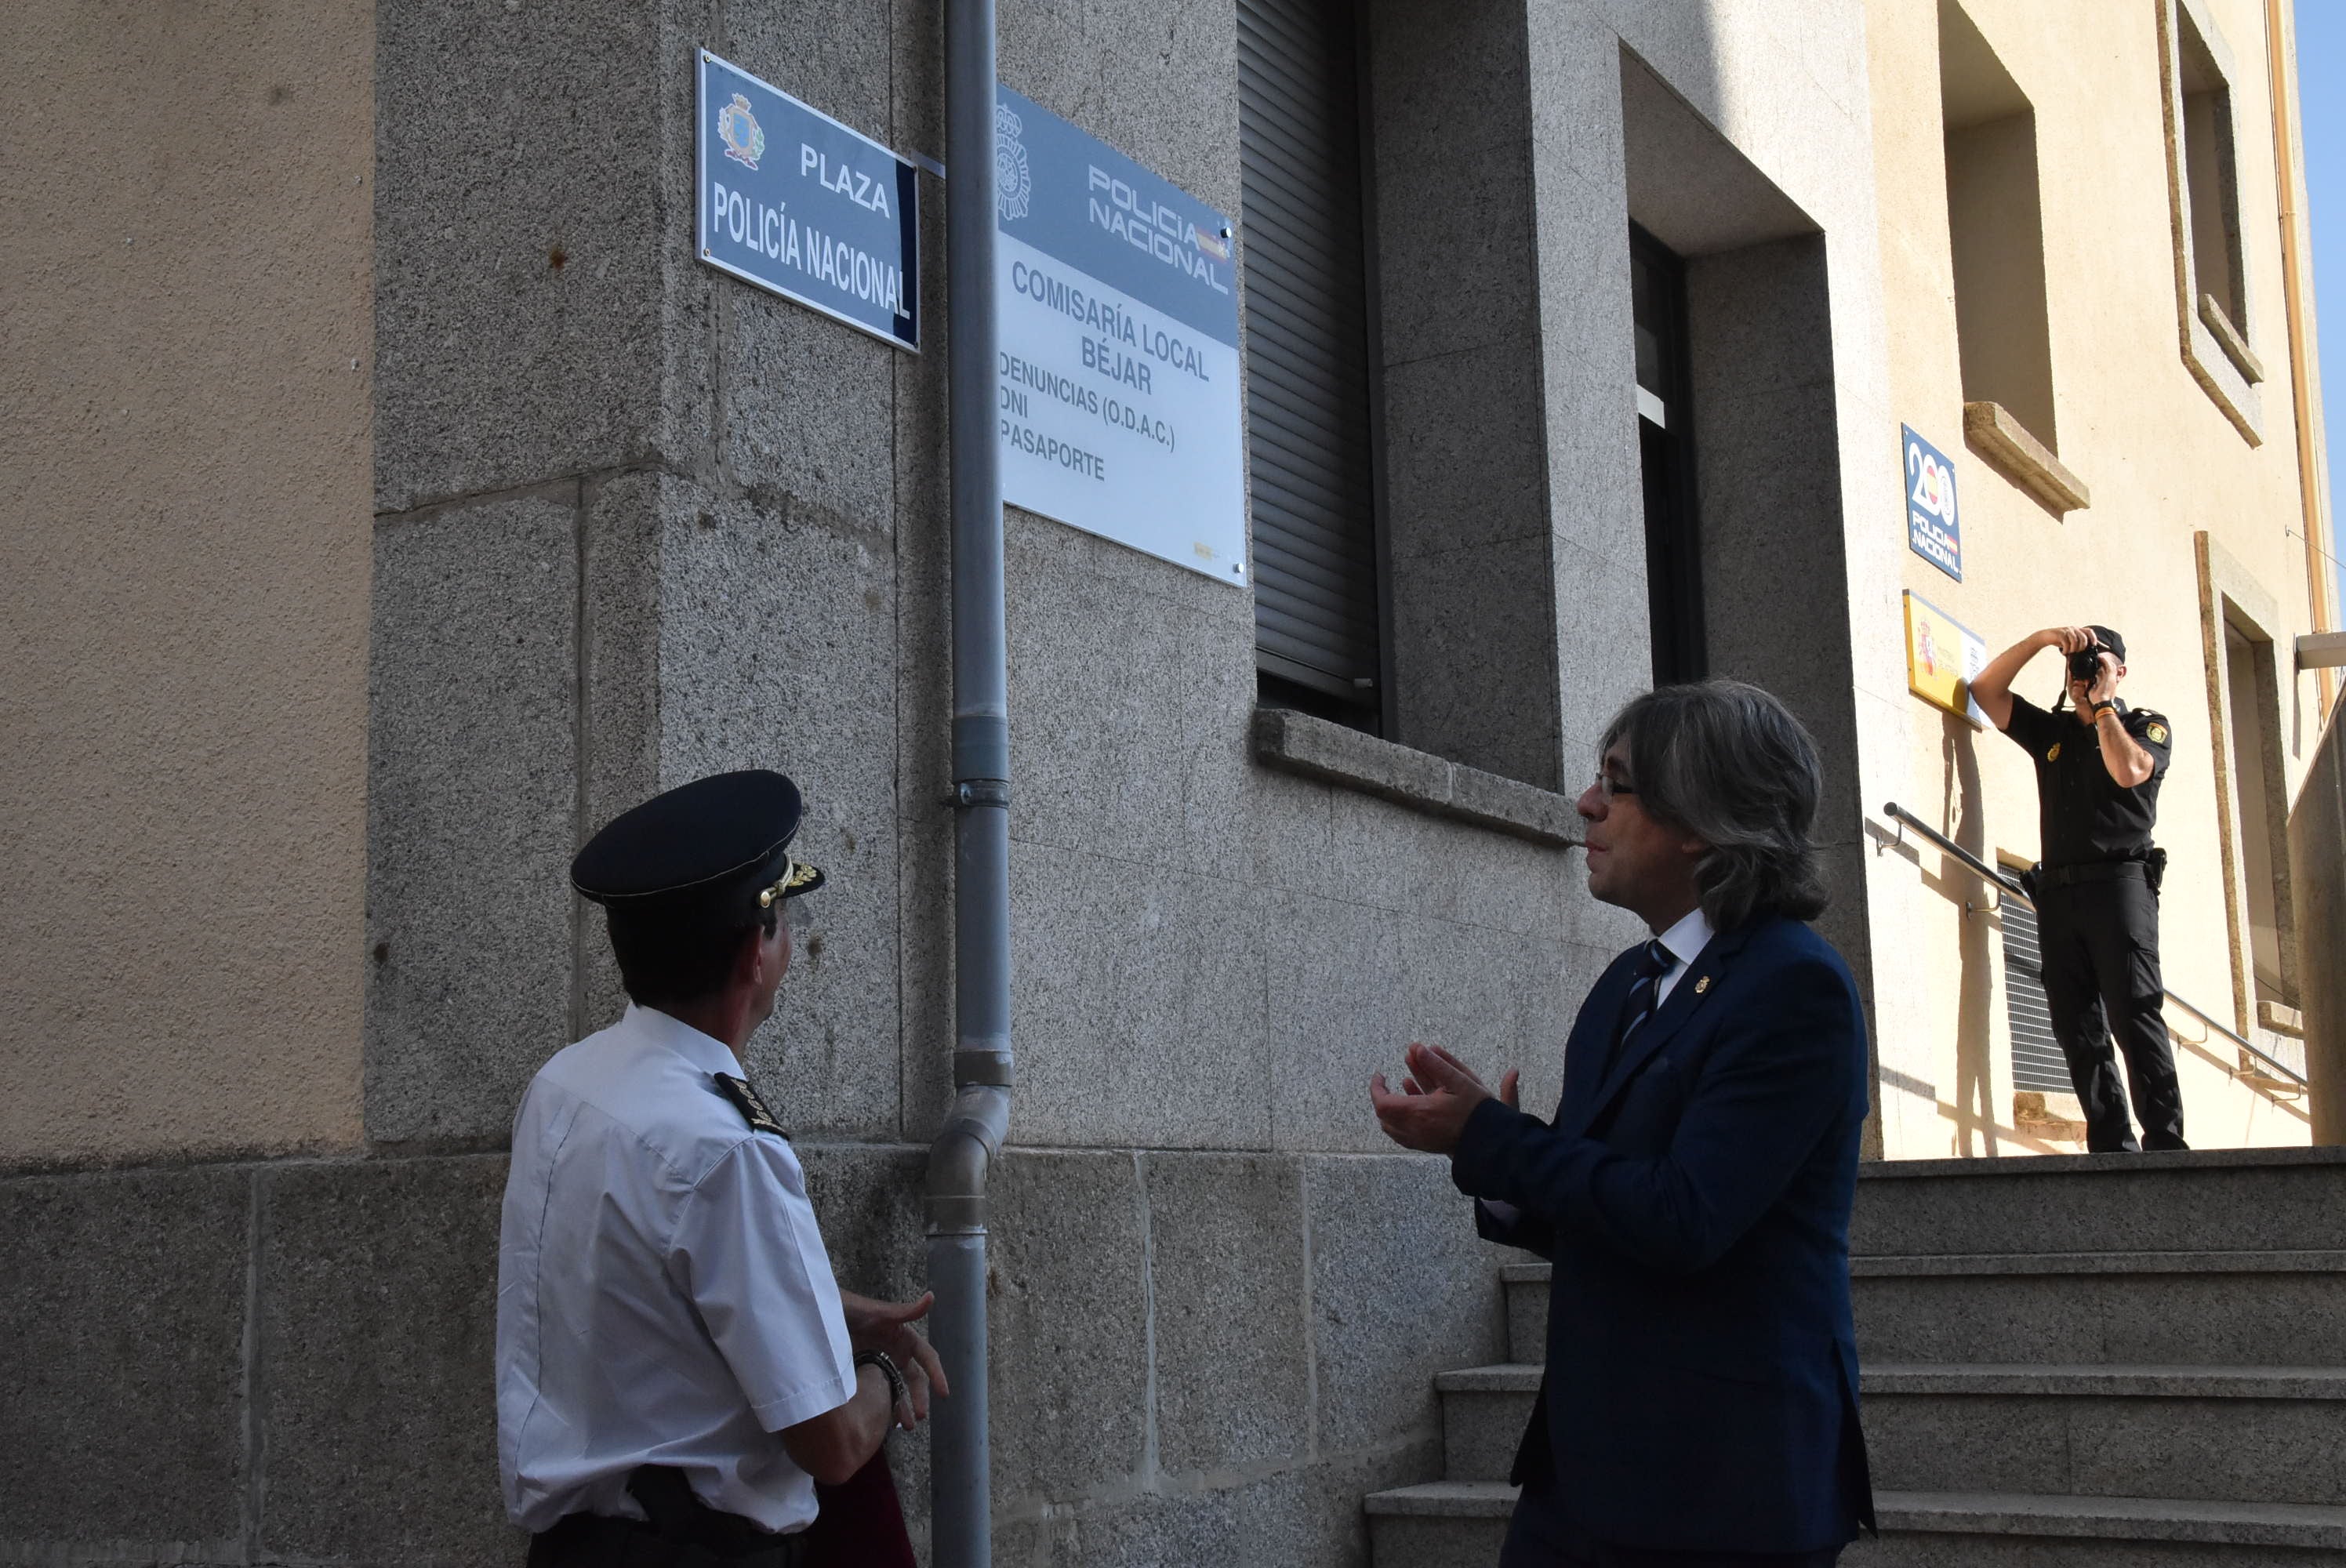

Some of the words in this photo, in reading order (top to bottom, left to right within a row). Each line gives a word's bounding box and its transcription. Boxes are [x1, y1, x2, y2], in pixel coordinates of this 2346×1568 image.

[801, 143, 891, 220] PLAZA
[714, 181, 802, 270] POLICÍA
[806, 226, 910, 320] NACIONAL
[1089, 198, 1229, 295] NACIONAL
[1012, 260, 1137, 347] COMISARÍA
[1142, 324, 1210, 382] LOCAL
[1000, 351, 1098, 415] DENUNCIAS
[1102, 397, 1175, 453] (O.D.A.C.)
[1081, 336, 1152, 395] BÉJAR
[1001, 419, 1105, 481] PASAPORTE
[1908, 442, 1956, 526] 200
[1913, 529, 1959, 573] NACIONAL
